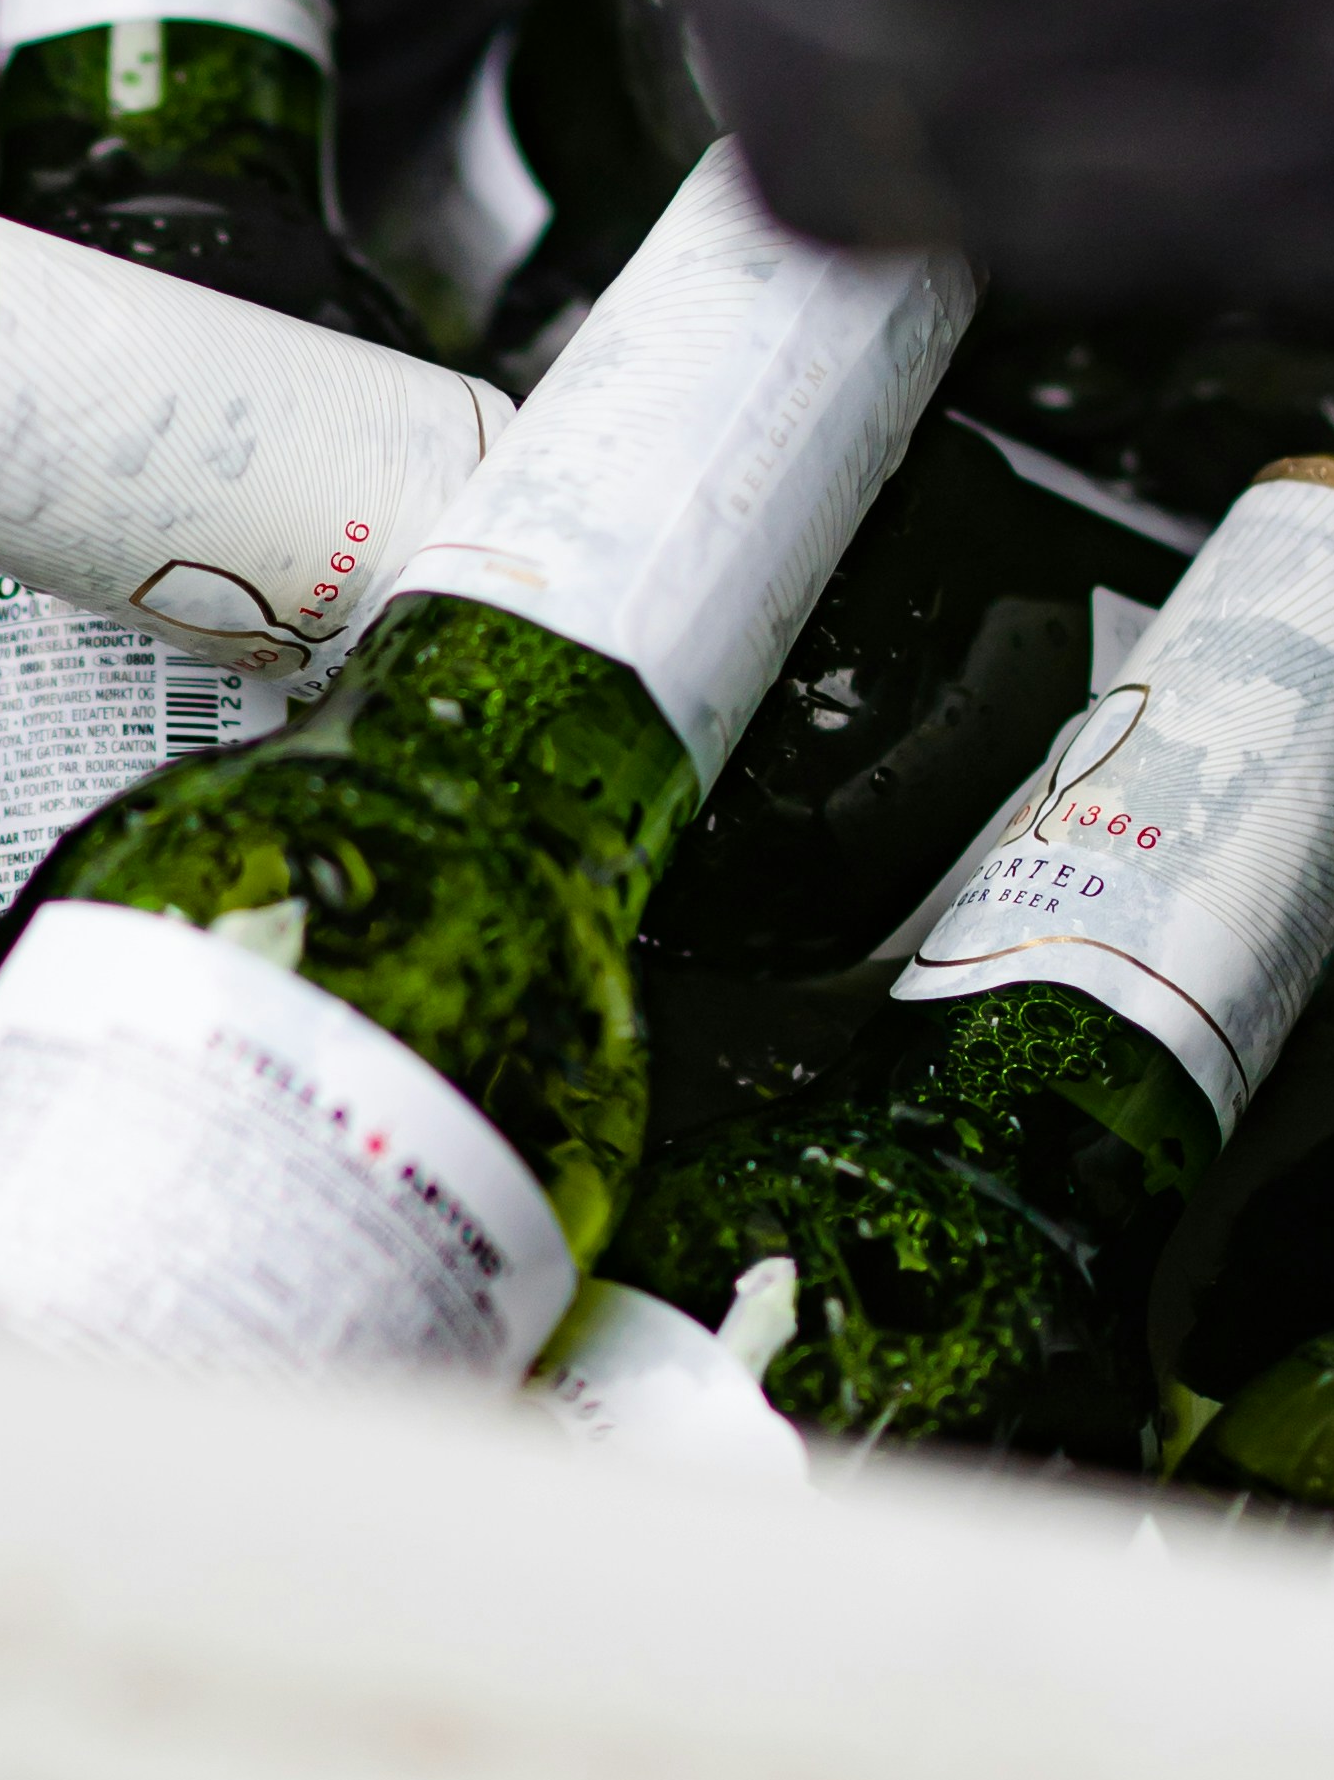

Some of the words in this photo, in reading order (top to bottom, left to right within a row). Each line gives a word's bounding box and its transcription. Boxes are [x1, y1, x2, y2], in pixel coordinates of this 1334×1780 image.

[730, 361, 829, 516] BELGIUM
[298, 520, 370, 621] 1366
[137, 686, 156, 701] OG
[14, 746, 33, 763] THE
[95, 740, 108, 755] 25
[111, 738, 157, 754] CANTON
[23, 779, 64, 797] FOURTH
[67, 777, 88, 792] LOK
[92, 775, 121, 790] YANG
[23, 827, 44, 843] TOT
[1061, 802, 1162, 850] 1366
[14, 866, 30, 883] BIS
[998, 888, 1060, 913] BEER
